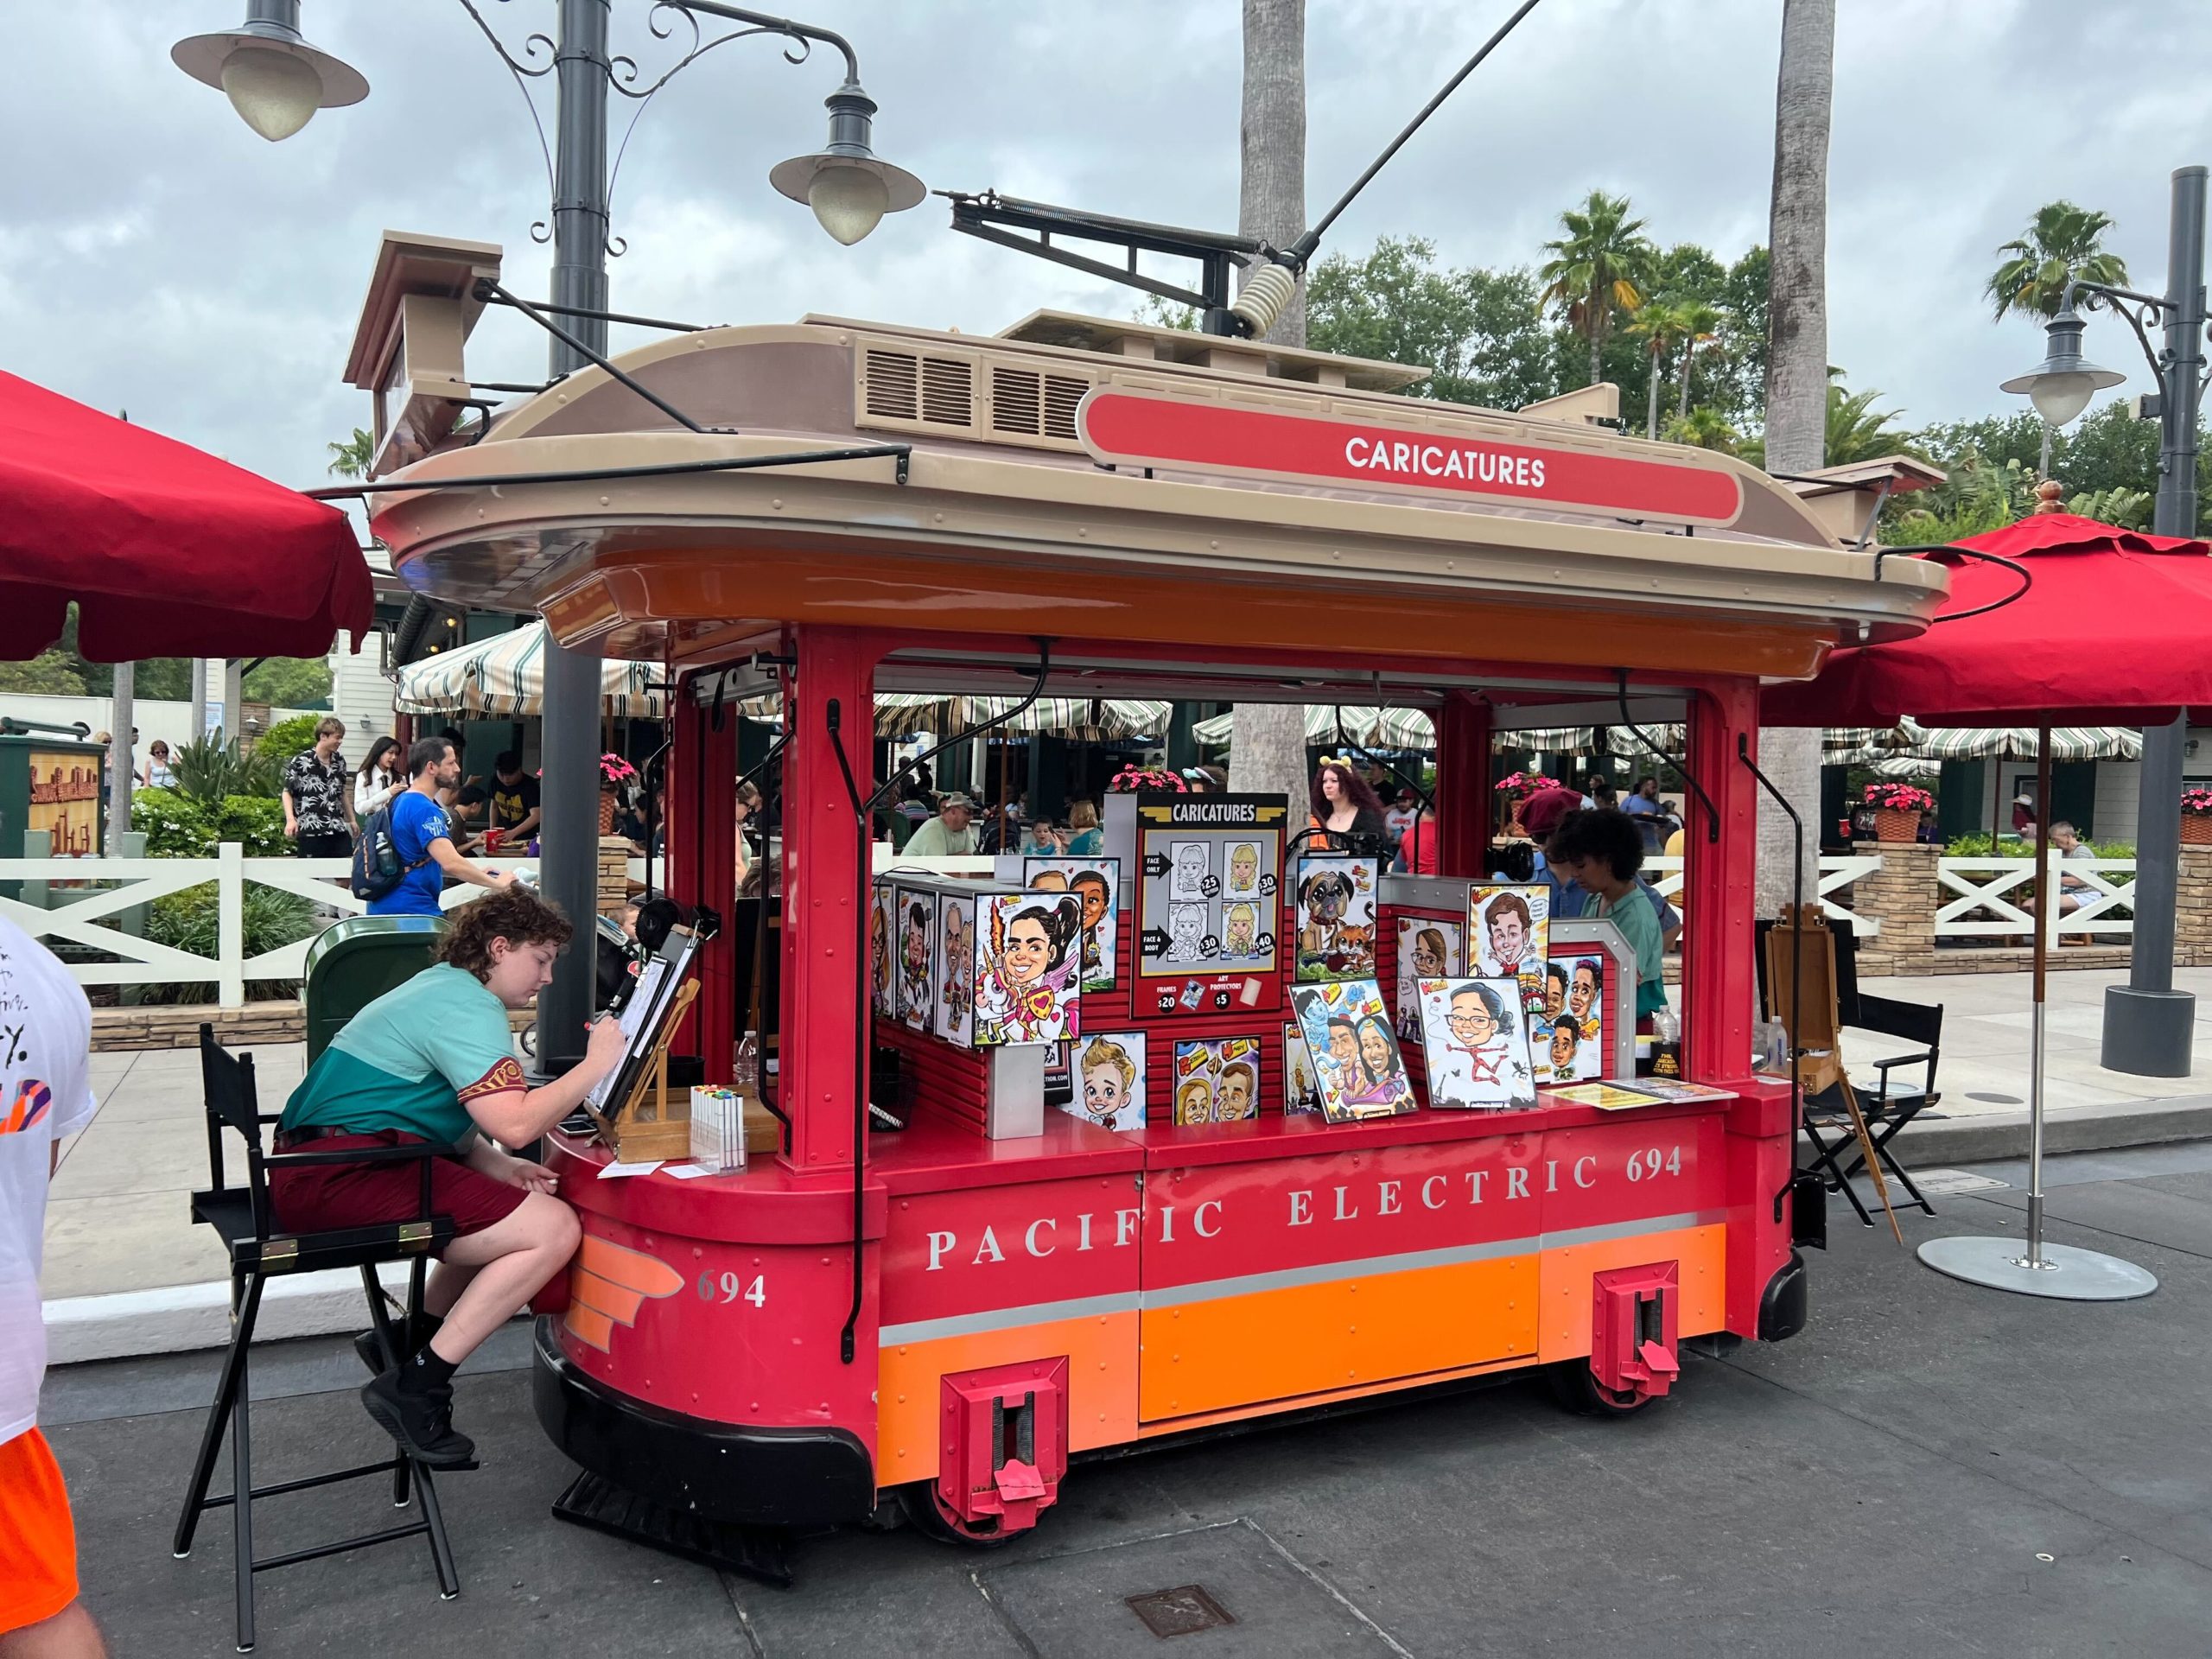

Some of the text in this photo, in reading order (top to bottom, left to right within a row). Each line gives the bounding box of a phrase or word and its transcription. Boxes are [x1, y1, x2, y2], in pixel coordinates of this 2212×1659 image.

[1345, 437, 1545, 487] CARICATURES
[1173, 804, 1255, 822] CARICATURES
[1201, 877, 1217, 889] $25
[1259, 876, 1274, 889] $30
[1200, 938, 1216, 950] $30
[1255, 936, 1271, 949] $40
[1158, 997, 1175, 1007] $20
[1216, 995, 1227, 1005] $5
[925, 1146, 1681, 1271] PACIFIC ELECTRIC 694
[697, 1269, 766, 1307] 694
